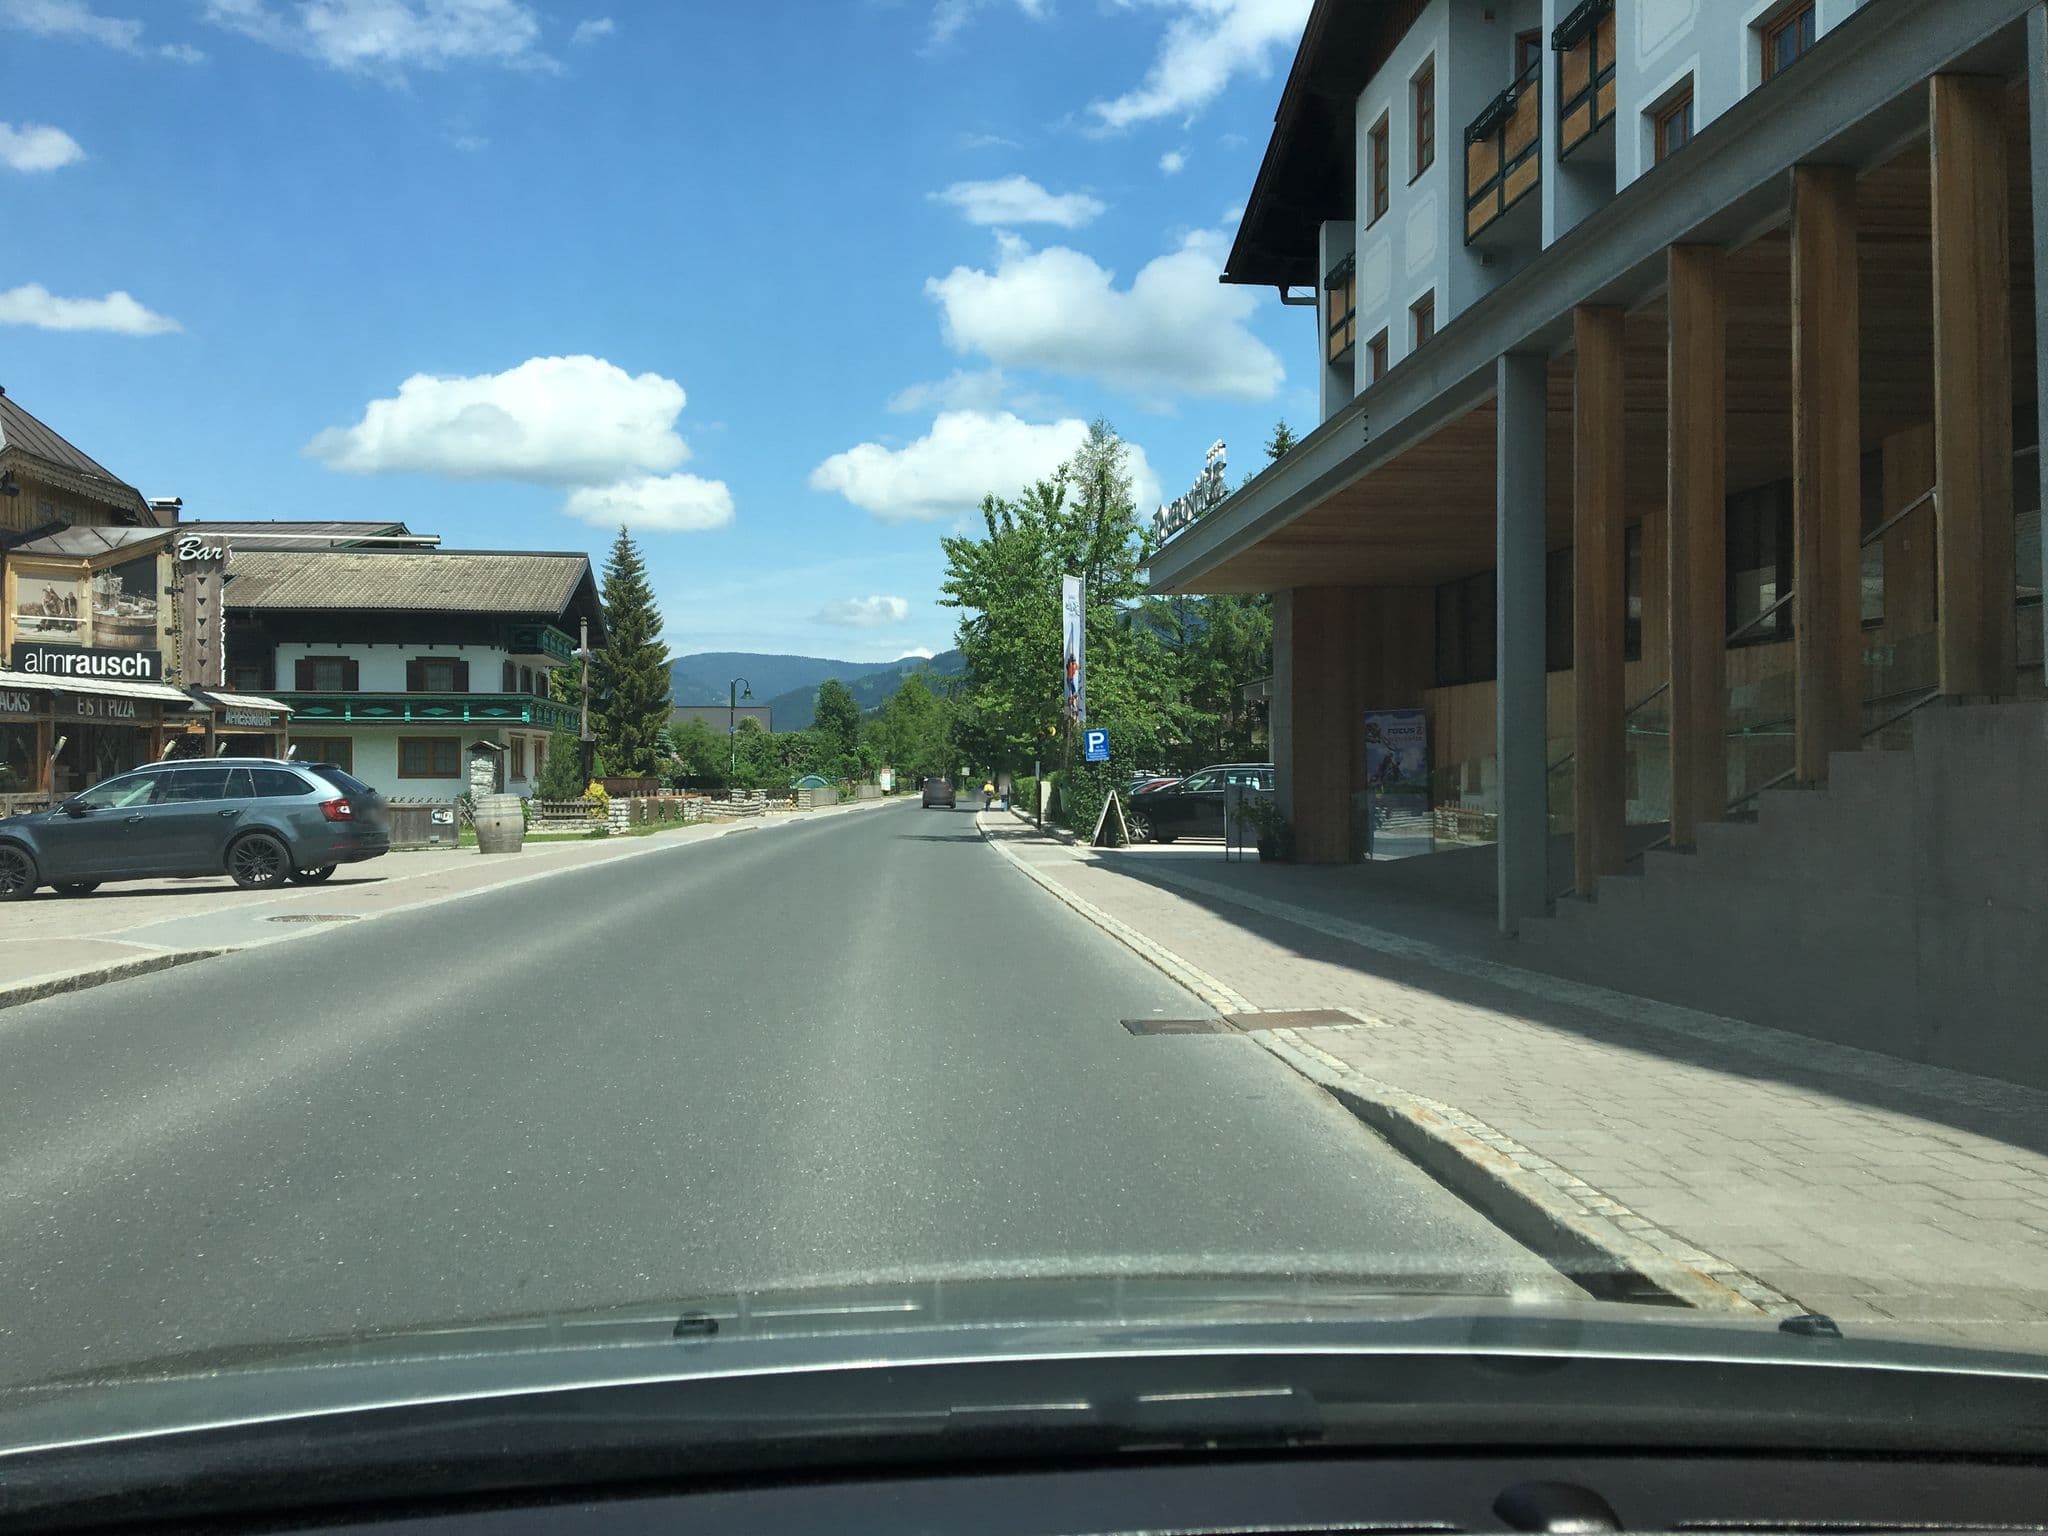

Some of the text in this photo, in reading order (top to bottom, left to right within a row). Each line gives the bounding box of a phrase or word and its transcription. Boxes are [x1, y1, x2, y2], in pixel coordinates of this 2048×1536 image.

[177, 536, 224, 561] Bar
[24, 648, 150, 677] almrausch
[108, 699, 136, 718] PIZZA
[1088, 732, 1105, 753] P
